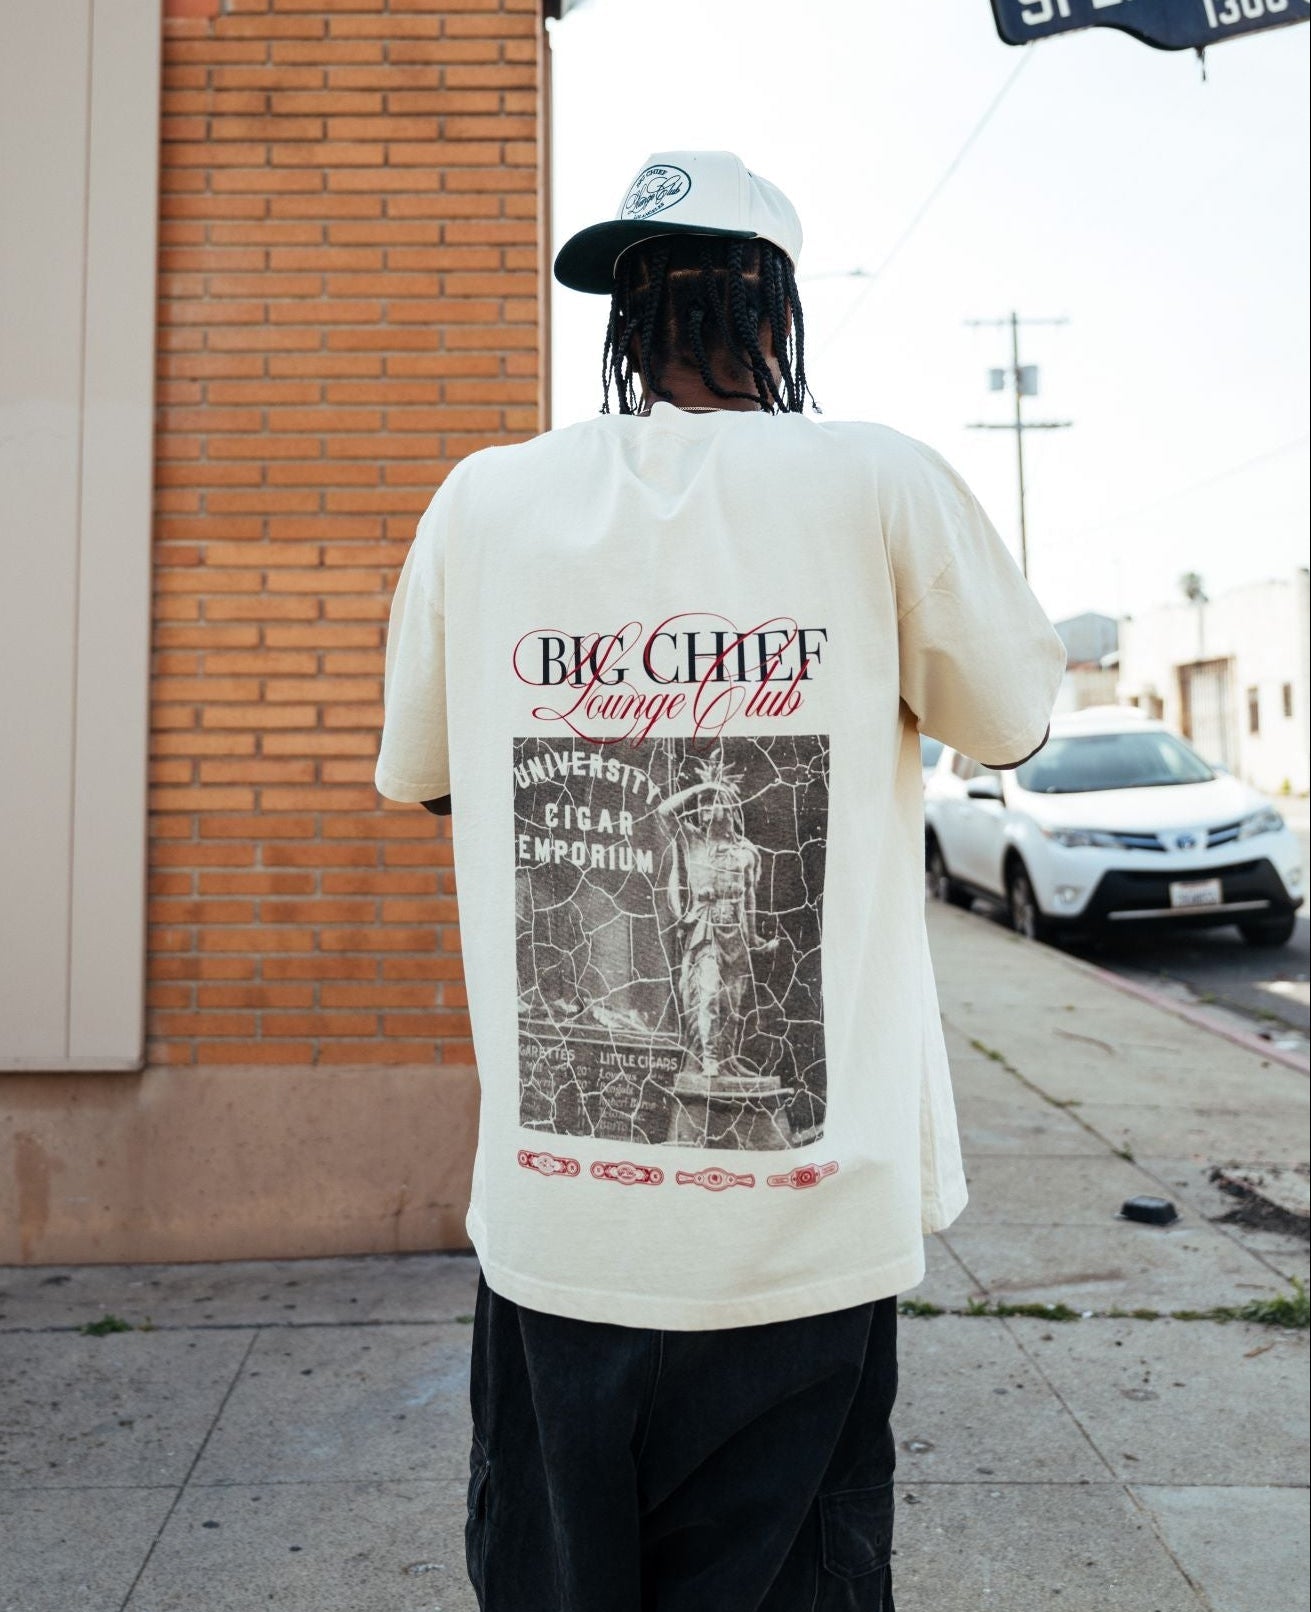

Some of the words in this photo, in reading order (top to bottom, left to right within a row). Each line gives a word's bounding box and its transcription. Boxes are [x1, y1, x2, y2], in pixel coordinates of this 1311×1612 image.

[537, 634, 630, 686] BIG
[642, 627, 829, 685] CHIEF
[512, 620, 688, 750] Lounge
[642, 612, 805, 750] Club
[513, 751, 661, 805] UNIVERSITY
[544, 802, 634, 836] CIGAR
[518, 833, 654, 874] EMPORIUM
[600, 1051, 637, 1068] LITTLE
[637, 1055, 678, 1072] CIGARS
